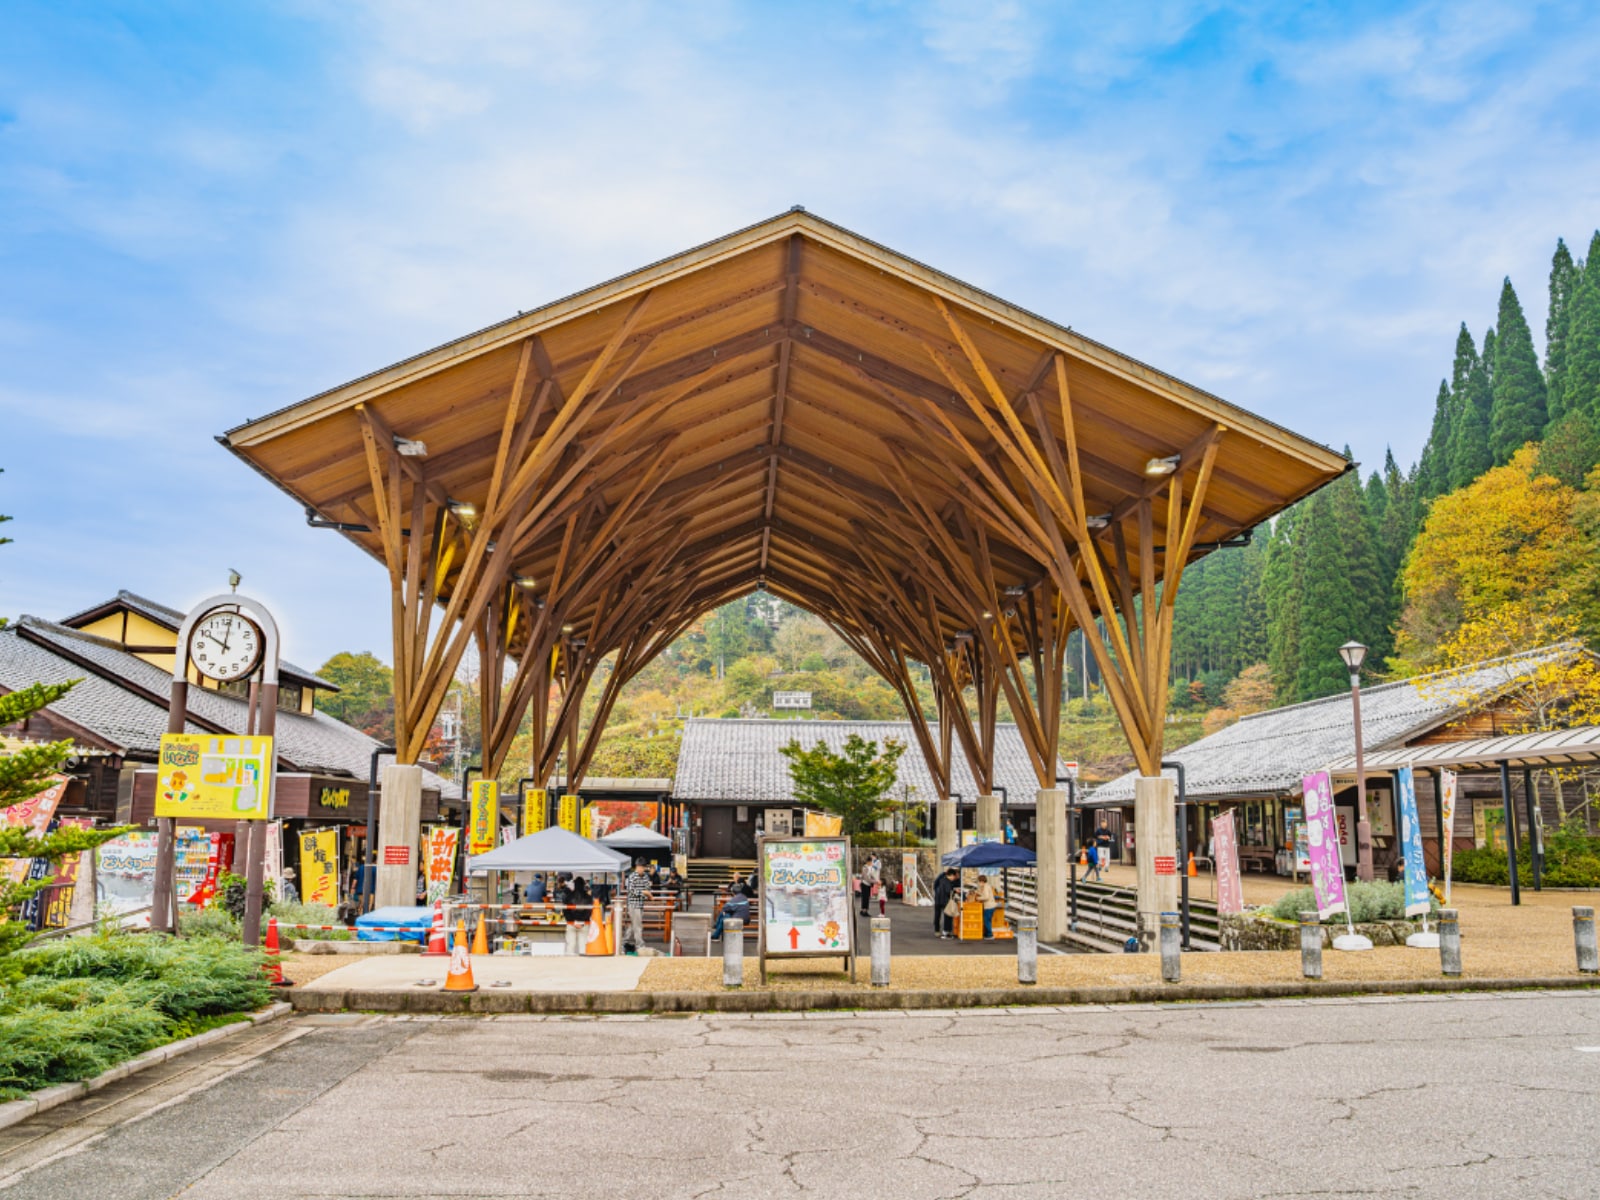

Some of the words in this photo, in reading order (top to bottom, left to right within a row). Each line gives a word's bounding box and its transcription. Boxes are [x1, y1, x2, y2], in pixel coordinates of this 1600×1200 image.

[200, 629, 211, 638] 10
[243, 630, 250, 639] 2
[197, 641, 205, 649] 9
[246, 643, 253, 651] 3
[200, 653, 207, 661] 8
[208, 662, 215, 670] 7
[219, 666, 227, 674] 6
[232, 663, 239, 671] 5
[772, 868, 841, 886] どんぐりの湯
